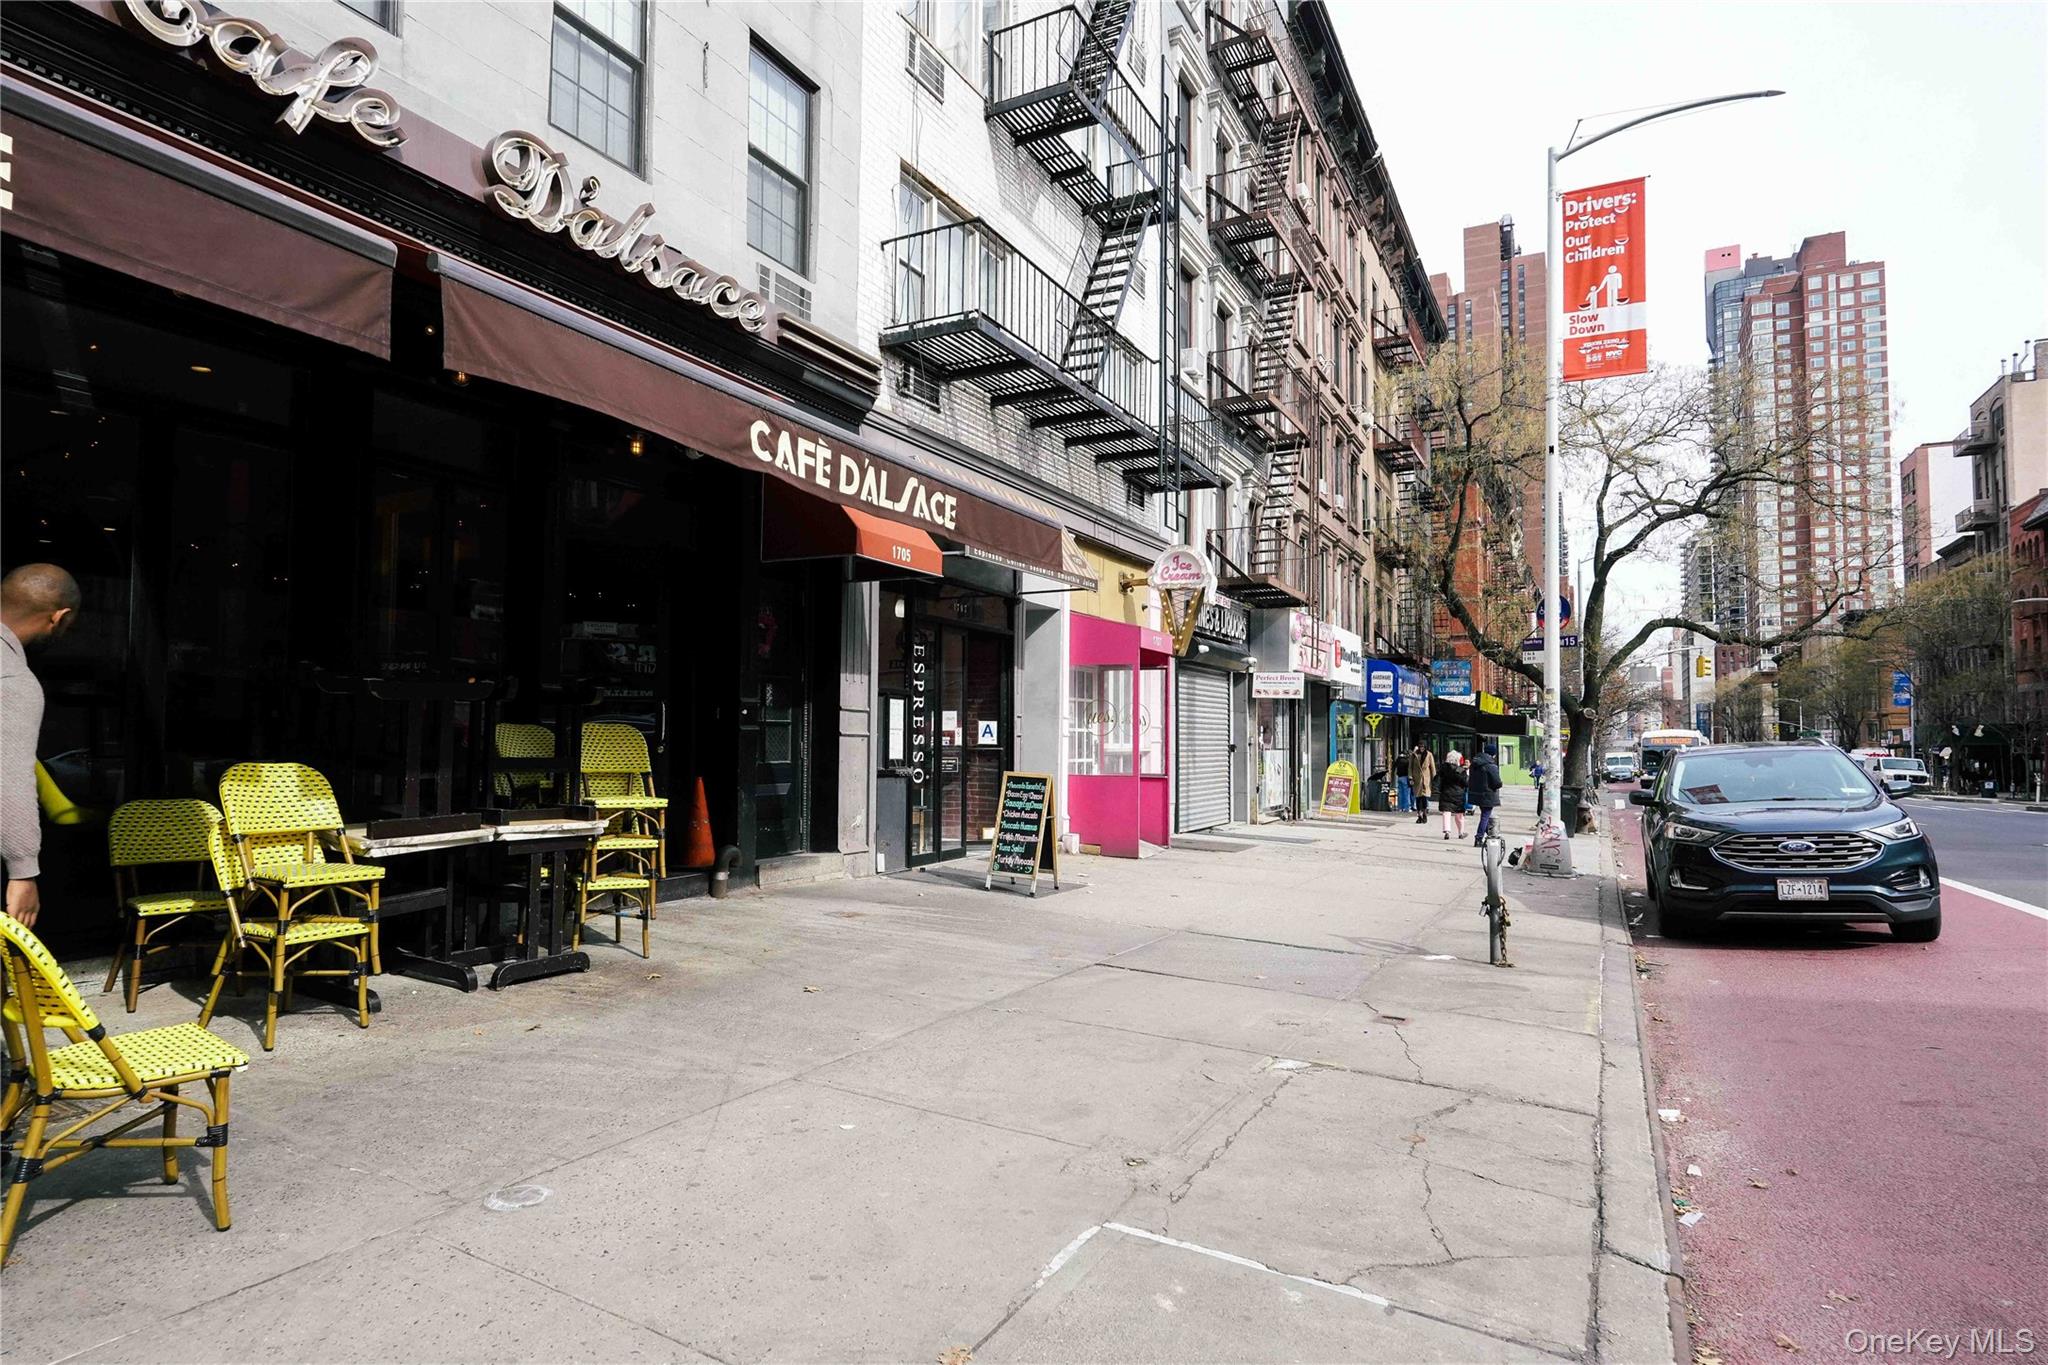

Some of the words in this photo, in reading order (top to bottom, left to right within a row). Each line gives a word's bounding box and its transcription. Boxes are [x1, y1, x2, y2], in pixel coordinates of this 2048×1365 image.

[1565, 192, 1637, 216] Drivers:
[1565, 212, 1616, 232] Protect
[1565, 235, 1591, 248] Our
[1565, 244, 1625, 264] Children
[1569, 313, 1599, 325] Slow
[1569, 324, 1605, 335] Down
[839, 453, 957, 531] D'ALSACE
[892, 544, 911, 562] 1705
[1172, 555, 1192, 571] Ice
[1160, 566, 1202, 580] Cream
[913, 645, 925, 784] ESPRESSO
[981, 723, 994, 738] A
